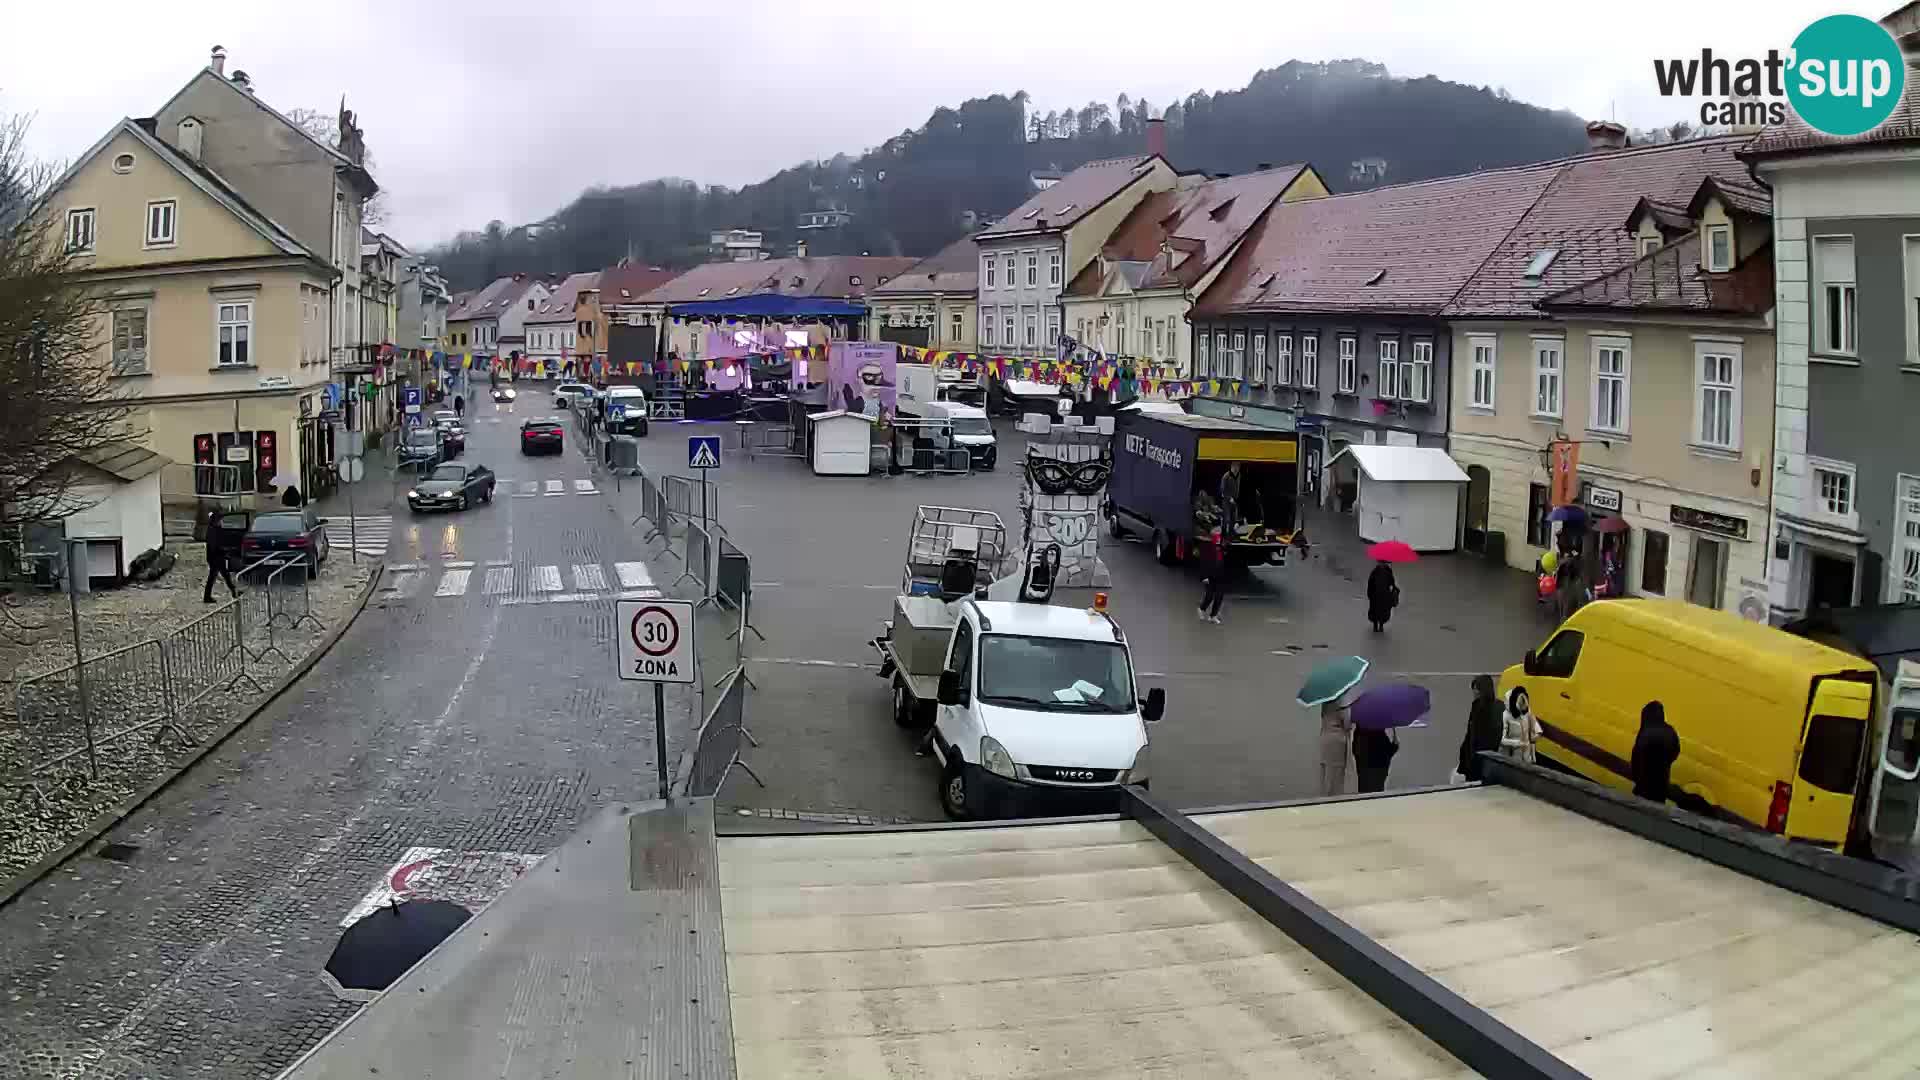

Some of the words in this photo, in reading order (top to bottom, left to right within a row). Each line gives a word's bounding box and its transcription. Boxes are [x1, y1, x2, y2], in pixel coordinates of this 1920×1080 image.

[1047, 515, 1087, 545] 200
[644, 622, 668, 643] 30
[634, 659, 678, 676] ZONA
[1055, 769, 1094, 780] IVECO
